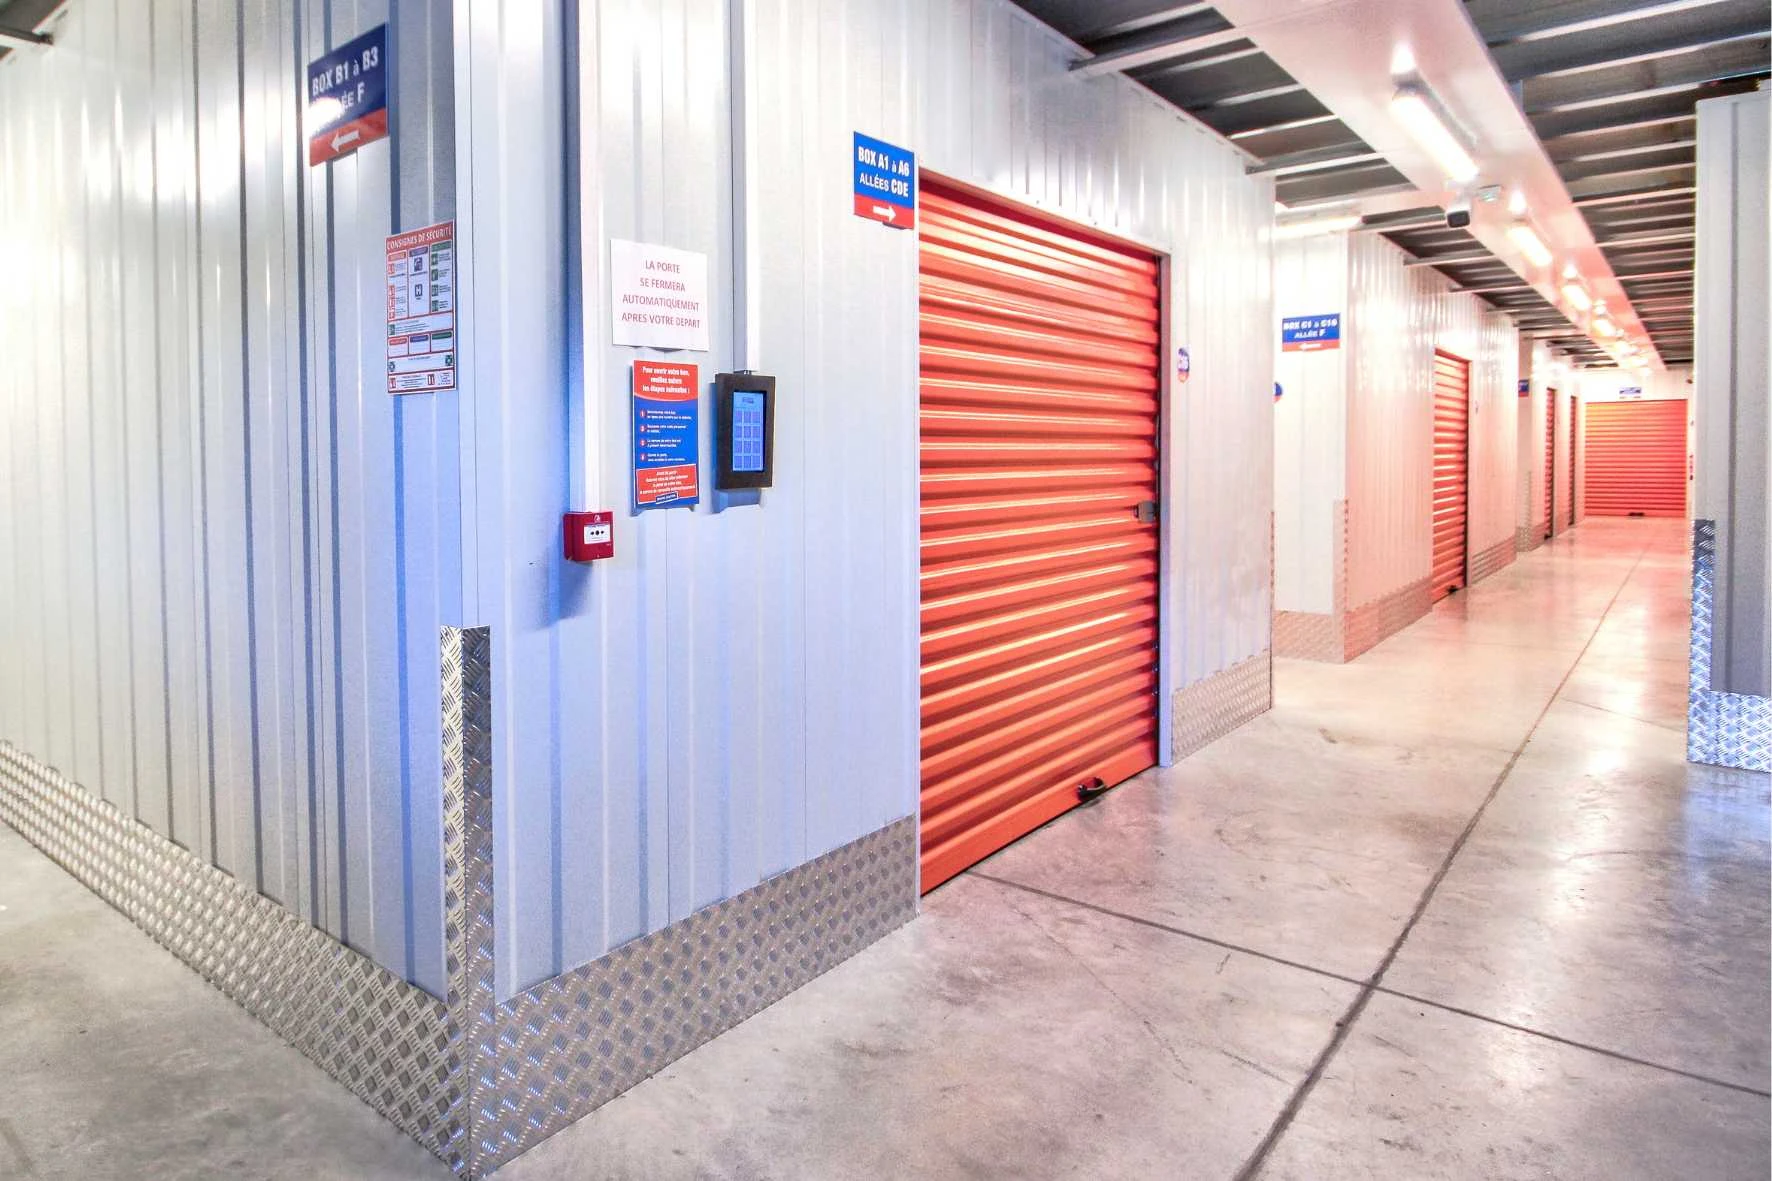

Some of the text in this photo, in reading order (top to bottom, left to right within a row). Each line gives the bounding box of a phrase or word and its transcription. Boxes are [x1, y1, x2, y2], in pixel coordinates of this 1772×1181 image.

[312, 45, 379, 97] BOX B1 à B3
[357, 81, 365, 104] F
[858, 146, 876, 167] BOX
[878, 153, 889, 170] A1
[898, 159, 910, 177] A6
[859, 172, 909, 198] ALLÉES CDE
[645, 259, 681, 274] LA PORTE
[639, 277, 686, 292] SE FERMERA
[622, 294, 700, 312] AUTOMATIQUEMENT
[621, 312, 701, 329] APRES VOTRE DEPART
[1283, 321, 1300, 330] BOX
